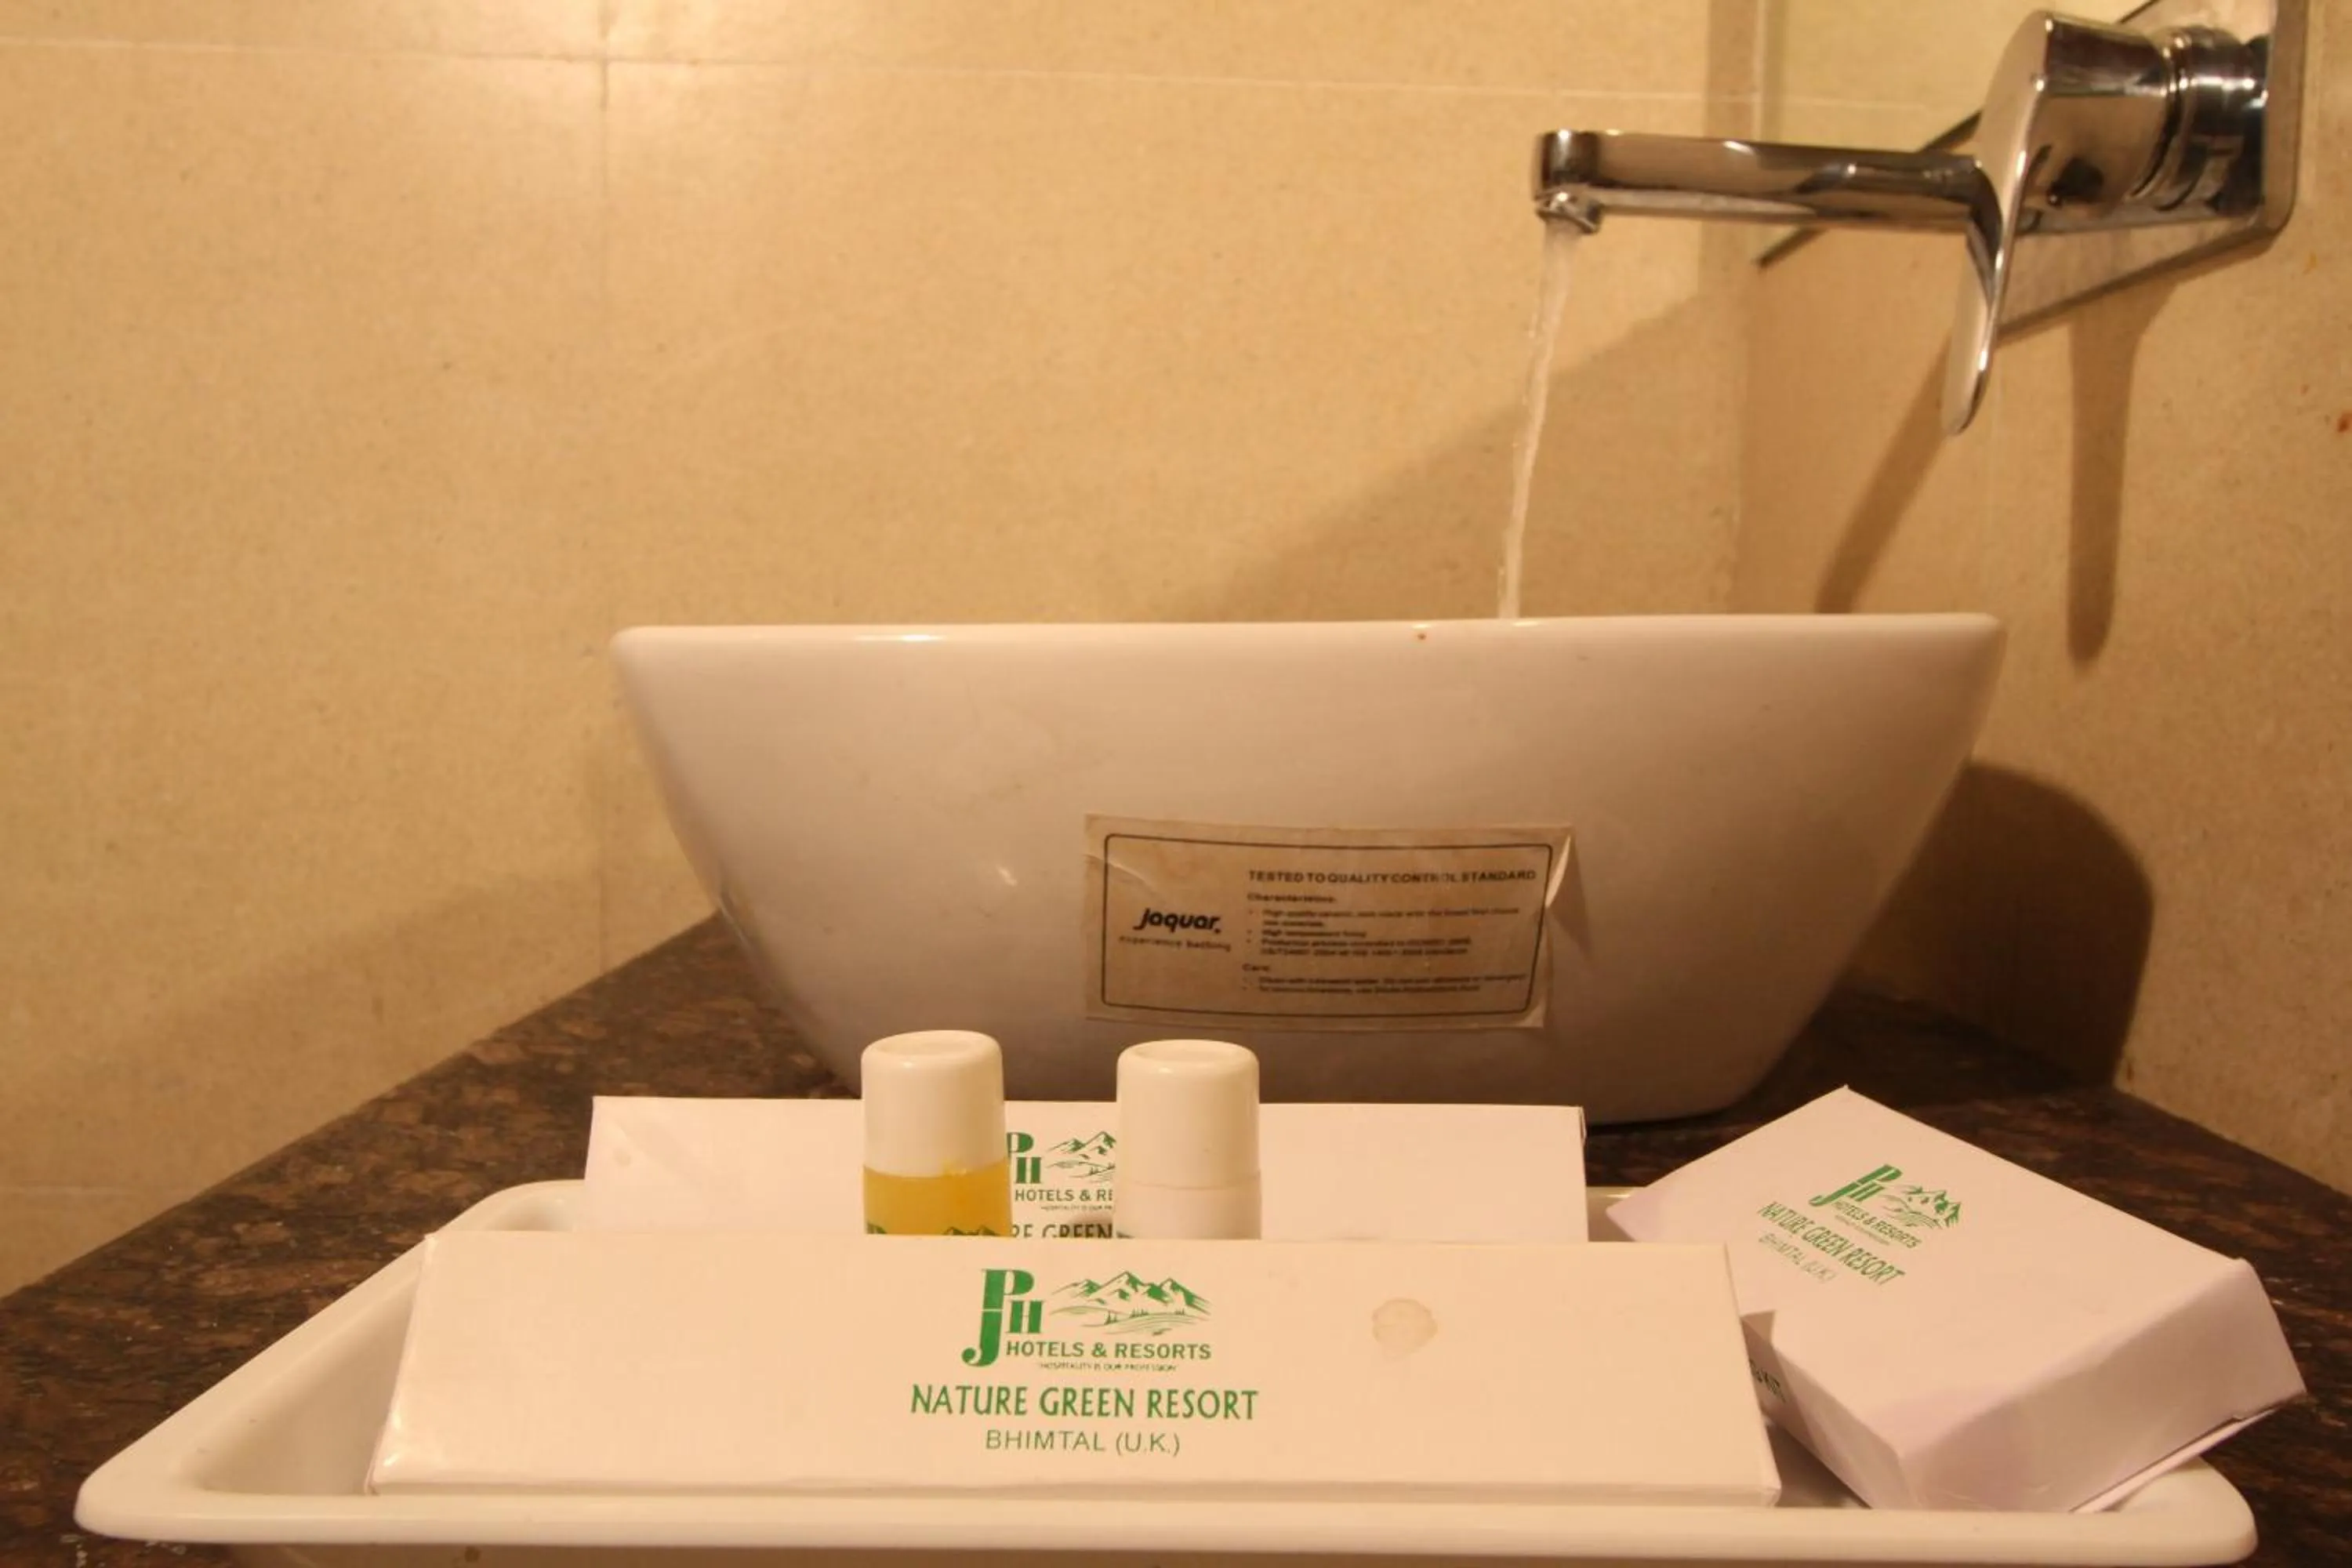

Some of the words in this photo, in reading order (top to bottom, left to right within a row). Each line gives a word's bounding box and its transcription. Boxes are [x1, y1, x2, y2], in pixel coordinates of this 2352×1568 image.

[1249, 870, 1304, 883] TESTED
[1307, 872, 1326, 883] TO
[1327, 872, 1389, 884] QUALITY
[1390, 873, 1457, 884] CONTROL
[1461, 869, 1537, 882] STANDARD
[1014, 1189, 1075, 1202] HOTELS
[1079, 1189, 1091, 1202] &
[1042, 1223, 1113, 1239] GREEN
[1873, 1220, 1922, 1249] RESORTS
[1757, 1201, 1815, 1235] NATURE
[1801, 1226, 1855, 1258] GREEN
[1839, 1247, 1907, 1285] RESORT
[1006, 1341, 1084, 1357] HOTELS
[1091, 1341, 1107, 1358] &
[1114, 1342, 1212, 1360] RESORTS
[910, 1384, 1028, 1415] NATURE
[1039, 1387, 1135, 1418] GREEN
[1147, 1388, 1259, 1421] RESORT
[985, 1429, 1107, 1453] BHIMTAL
[1116, 1431, 1181, 1457] (U.K.)
